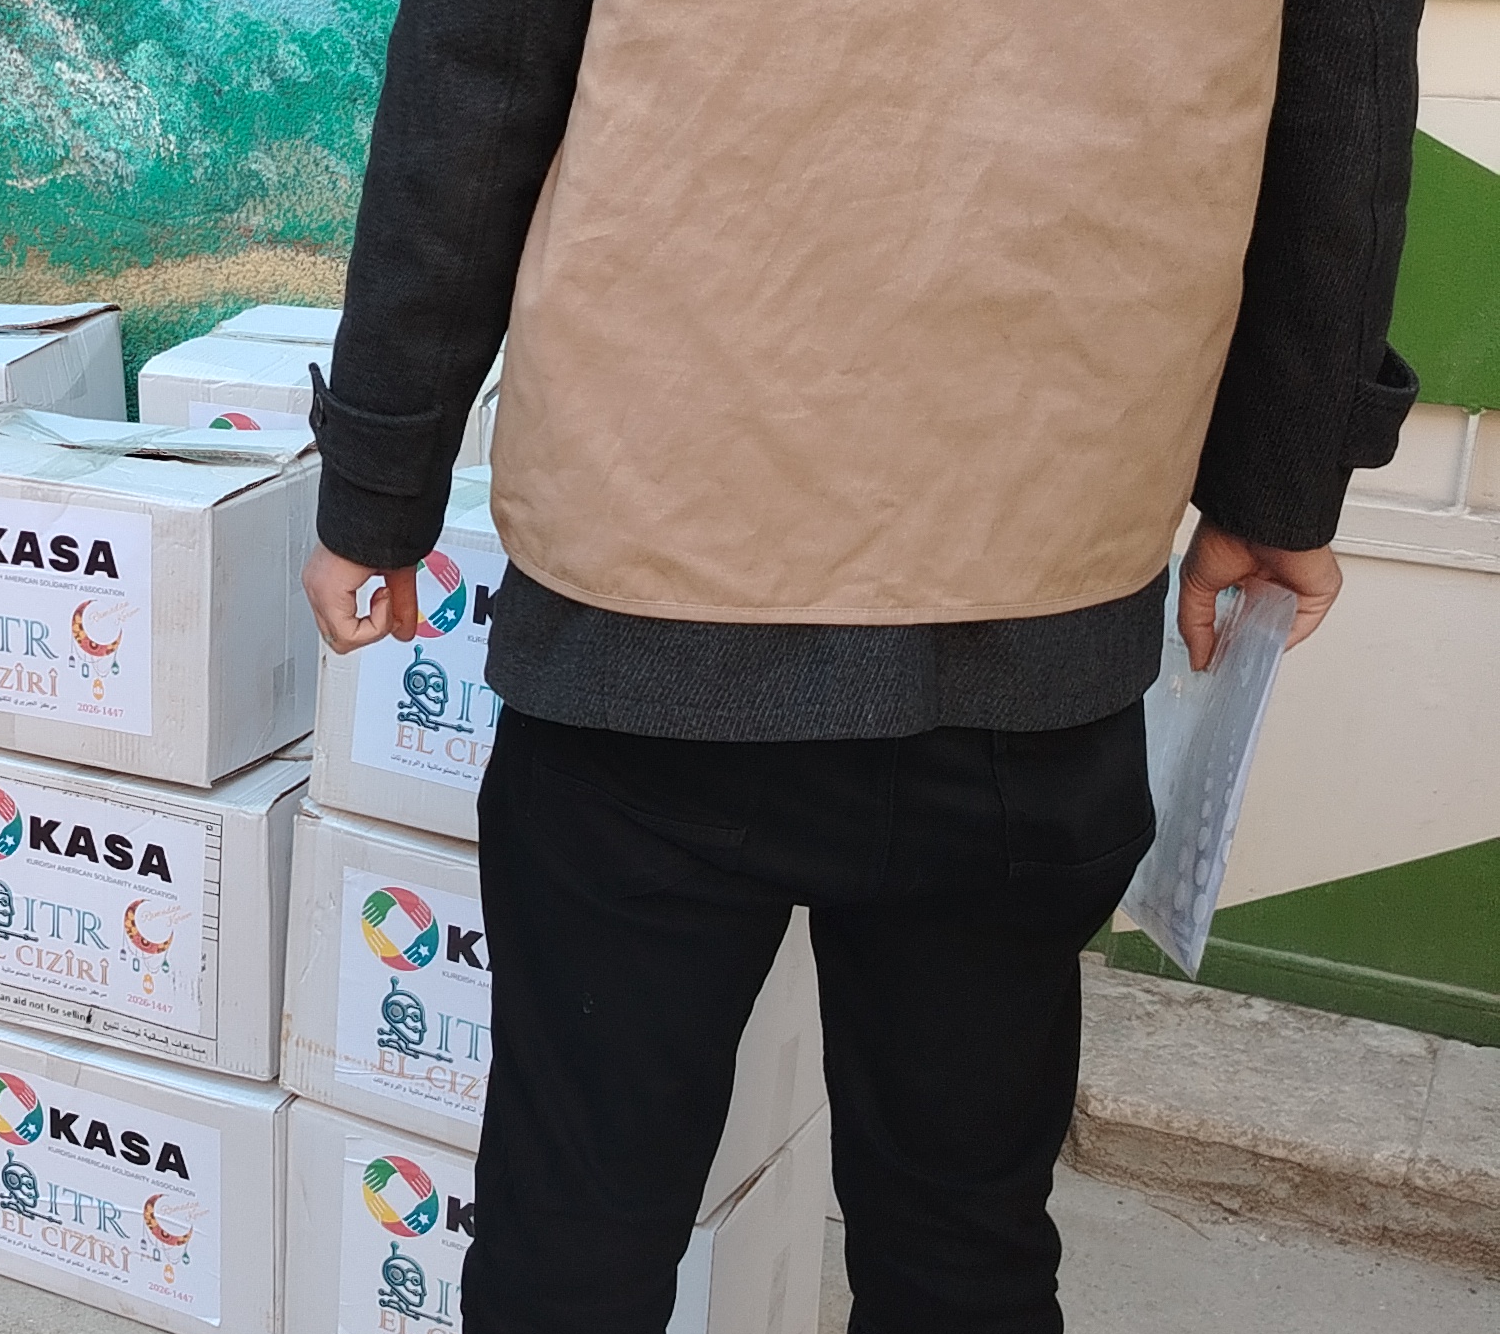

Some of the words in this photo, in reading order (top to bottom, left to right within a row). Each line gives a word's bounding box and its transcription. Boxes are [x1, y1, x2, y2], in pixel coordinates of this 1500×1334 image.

[76, 702, 125, 718] 2026-1447
[456, 679, 504, 729] IT
[396, 723, 435, 755] EL
[29, 815, 173, 884] KASA
[23, 895, 111, 951] ITR
[15, 944, 110, 987] CIZÎRÎ
[12, 994, 28, 1008] aid
[29, 999, 45, 1012] not
[46, 1002, 60, 1016] for
[126, 993, 174, 1015] 2026-1447
[436, 1011, 491, 1063] IT
[377, 1048, 418, 1081] EL
[49, 1106, 191, 1181] KASA
[47, 1181, 131, 1240] ITR
[1, 1209, 33, 1239] EL
[41, 1225, 131, 1274] CIZÎRÎ
[147, 1280, 194, 1304] 2026-1447
